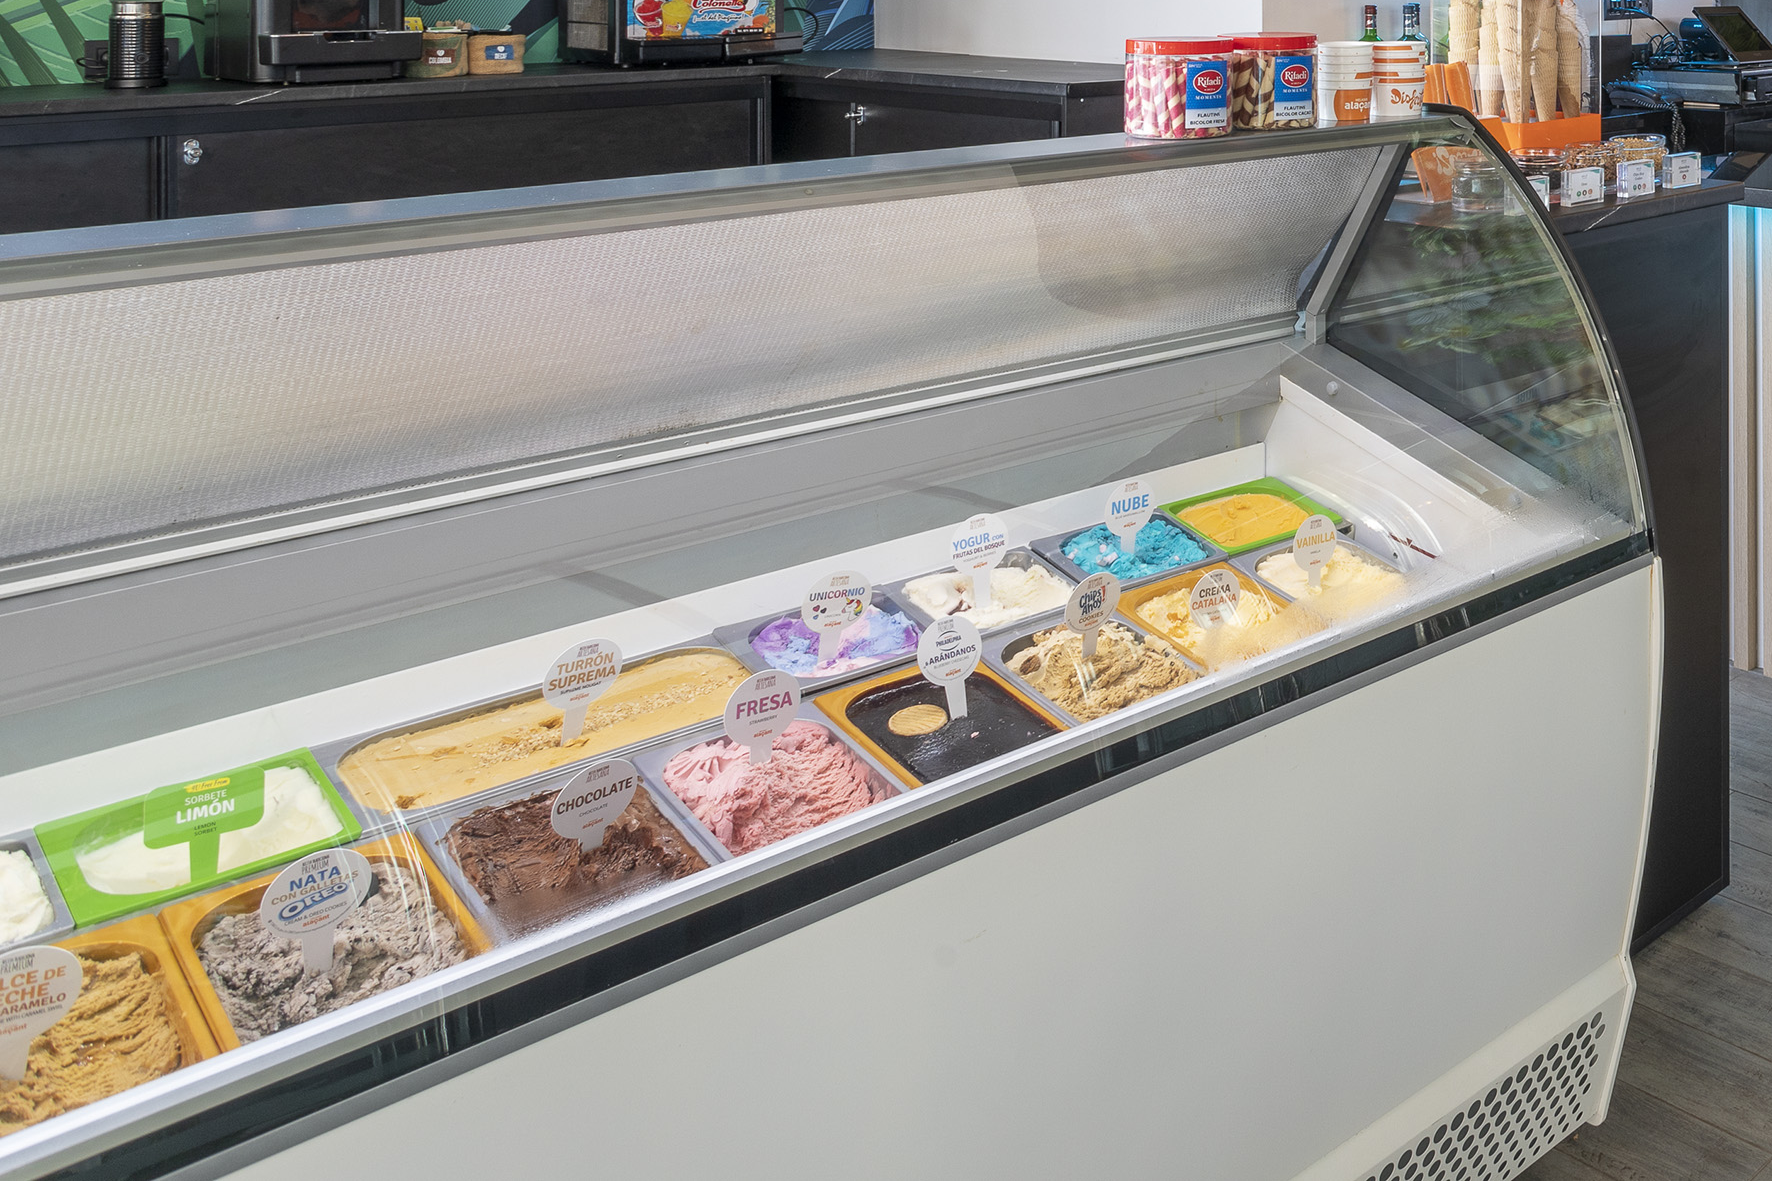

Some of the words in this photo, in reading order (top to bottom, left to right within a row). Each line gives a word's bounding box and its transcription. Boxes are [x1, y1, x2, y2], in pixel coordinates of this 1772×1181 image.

[1111, 493, 1149, 515] NUBE
[952, 532, 990, 552] YOGUR
[992, 533, 1004, 541] CON
[952, 549, 973, 560] FRUTAS
[974, 546, 984, 554] DEL
[984, 539, 1005, 551] BOSQUE
[1296, 531, 1336, 549] VAINILLA
[809, 587, 866, 602] UNICORNIO
[1079, 588, 1102, 608] Chips
[1078, 610, 1104, 624] COOKIES
[557, 651, 615, 676] TURRÓN
[929, 644, 977, 666] ARÁNDANOS
[547, 665, 616, 691] SUPREMA
[736, 691, 793, 720] FRESA
[184, 789, 228, 806] SORBETE
[556, 776, 634, 816] CHOCOLATE
[175, 798, 235, 825] LIMÓN
[579, 803, 609, 817] CHOCOLATE
[194, 821, 216, 831] LEMON
[194, 827, 217, 837] SORBET
[302, 859, 330, 875] PREMIUM
[271, 891, 297, 906] CON
[300, 870, 359, 896] GALLETAS
[289, 866, 341, 892] NATA
[278, 882, 349, 922] OREO
[284, 916, 304, 927] CREAM
[325, 901, 348, 913] COOKIES
[44, 965, 67, 981] DE
